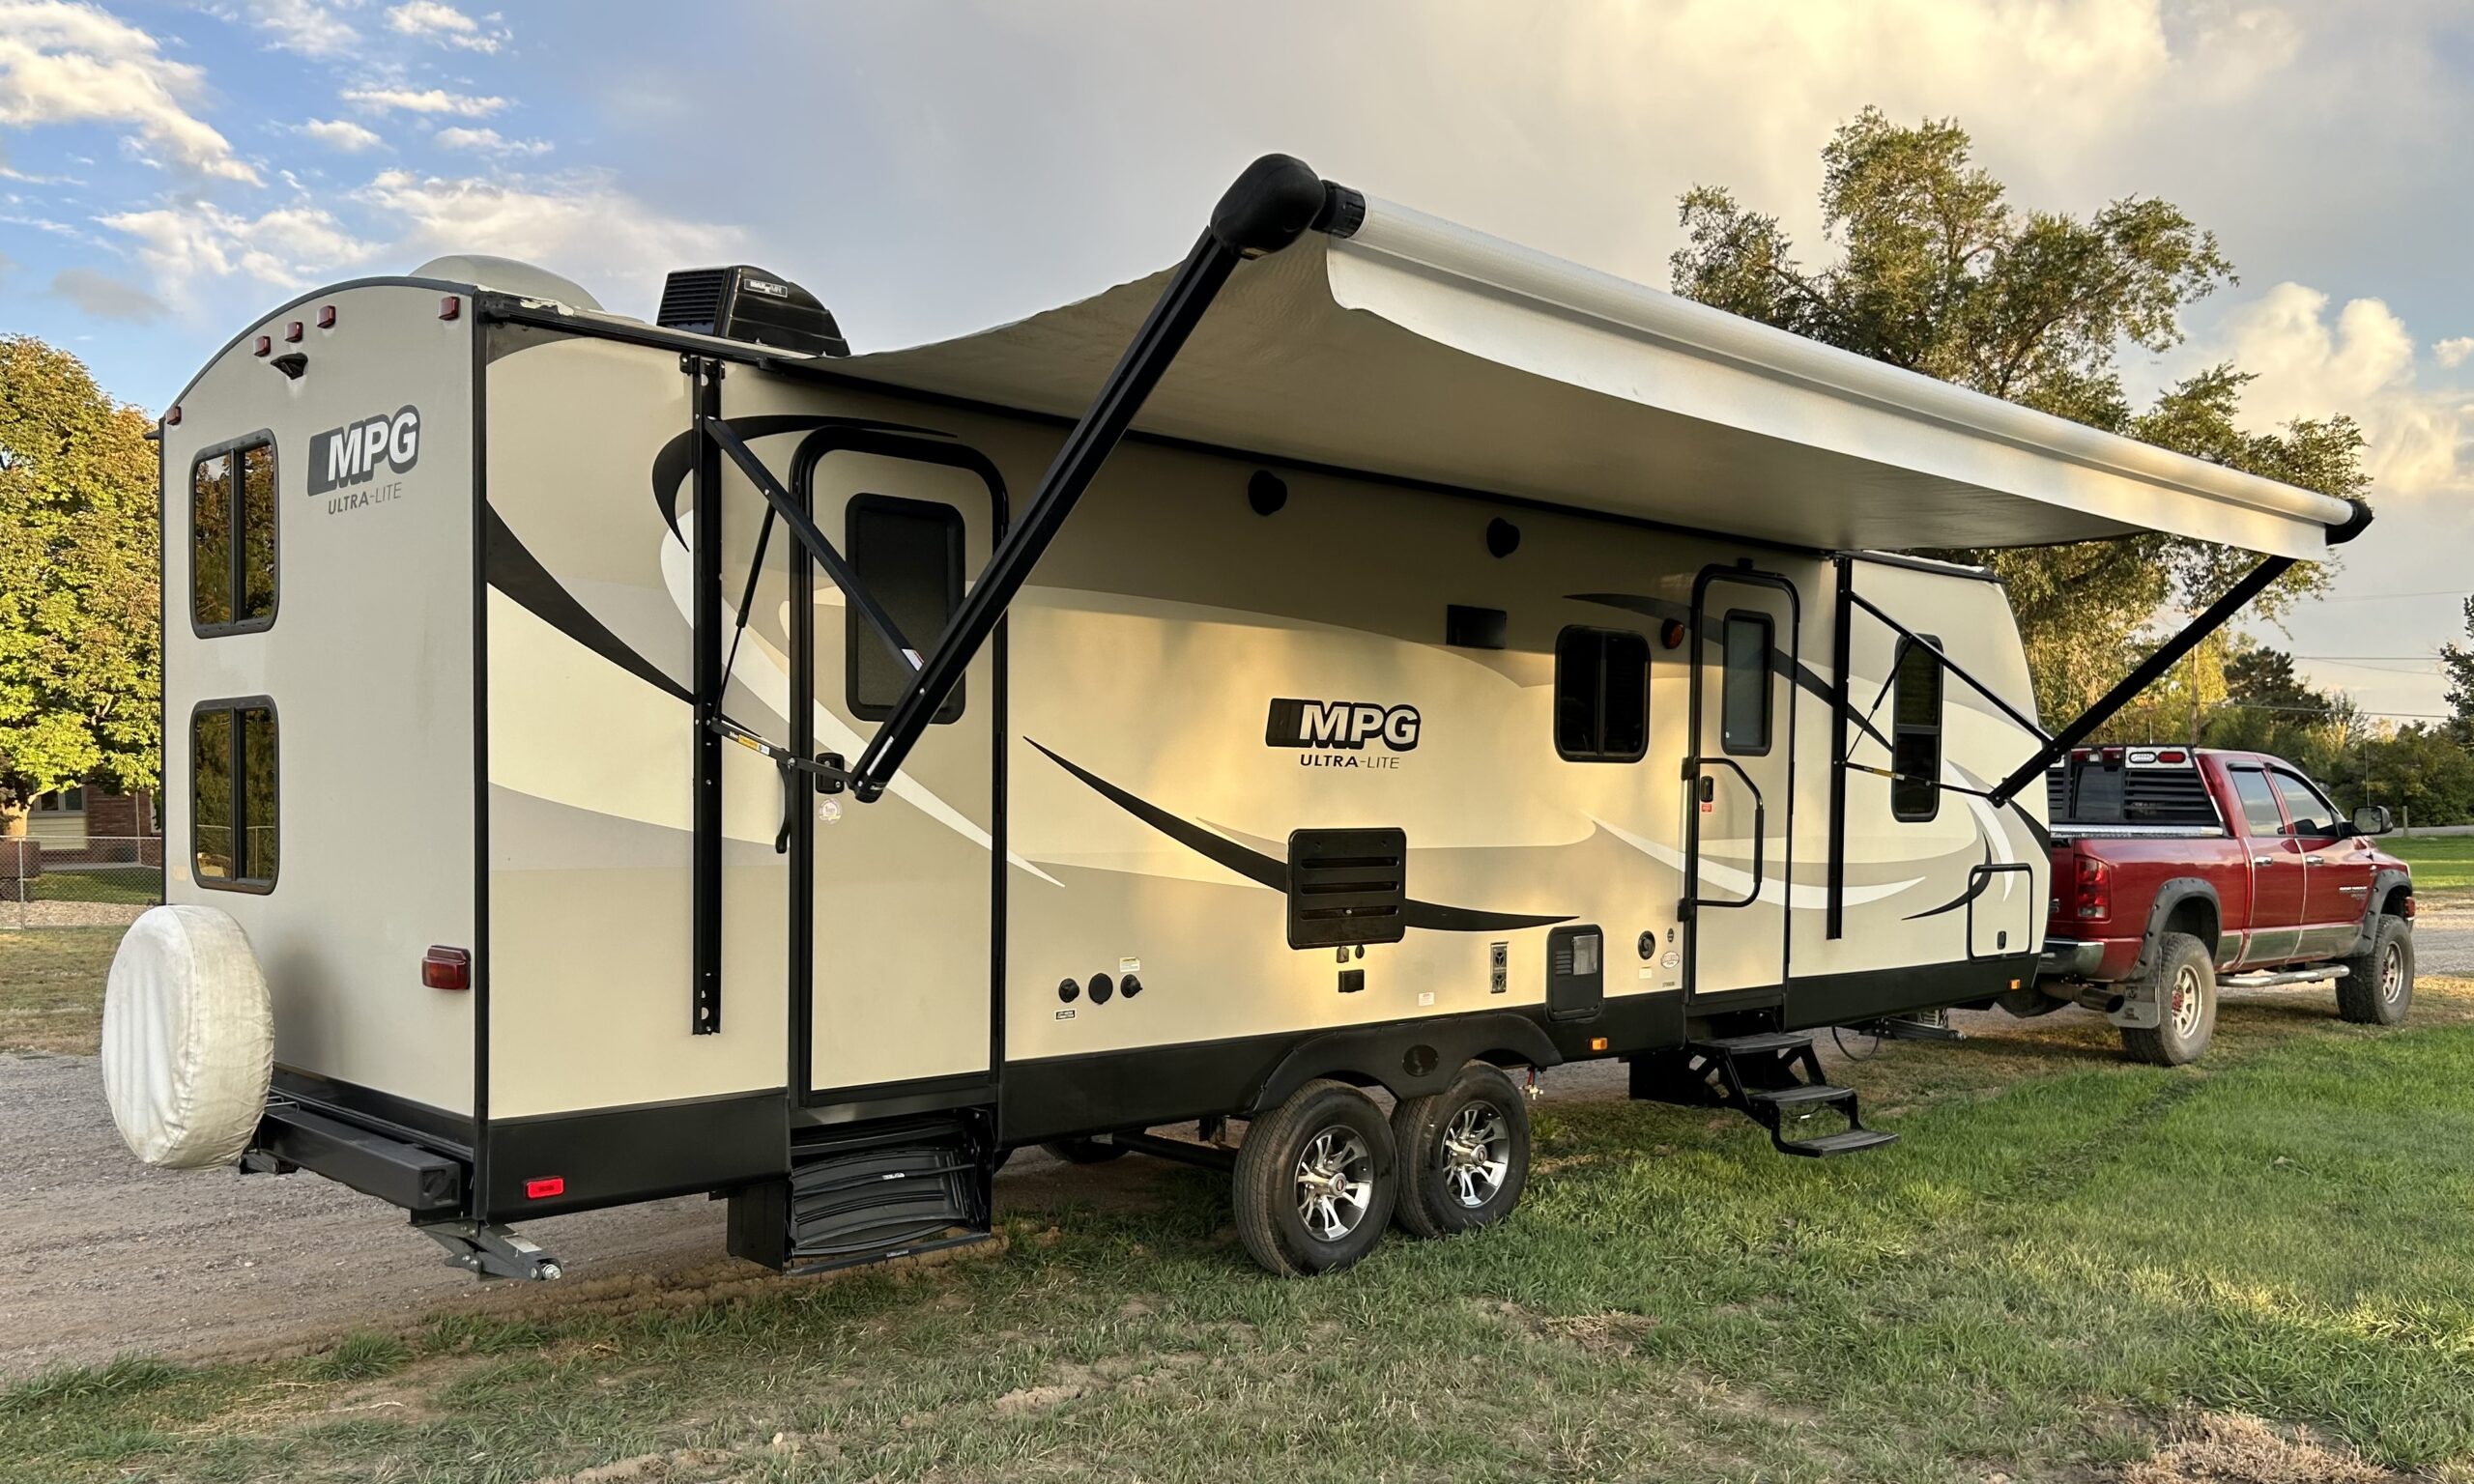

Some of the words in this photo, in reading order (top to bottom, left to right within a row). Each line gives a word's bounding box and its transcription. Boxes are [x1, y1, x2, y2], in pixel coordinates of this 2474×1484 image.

[327, 411, 418, 483] MPG
[328, 482, 403, 515] ULTRA-LITE
[1298, 703, 1419, 746] MPG
[1300, 754, 1400, 769] ULTRA-LITE
